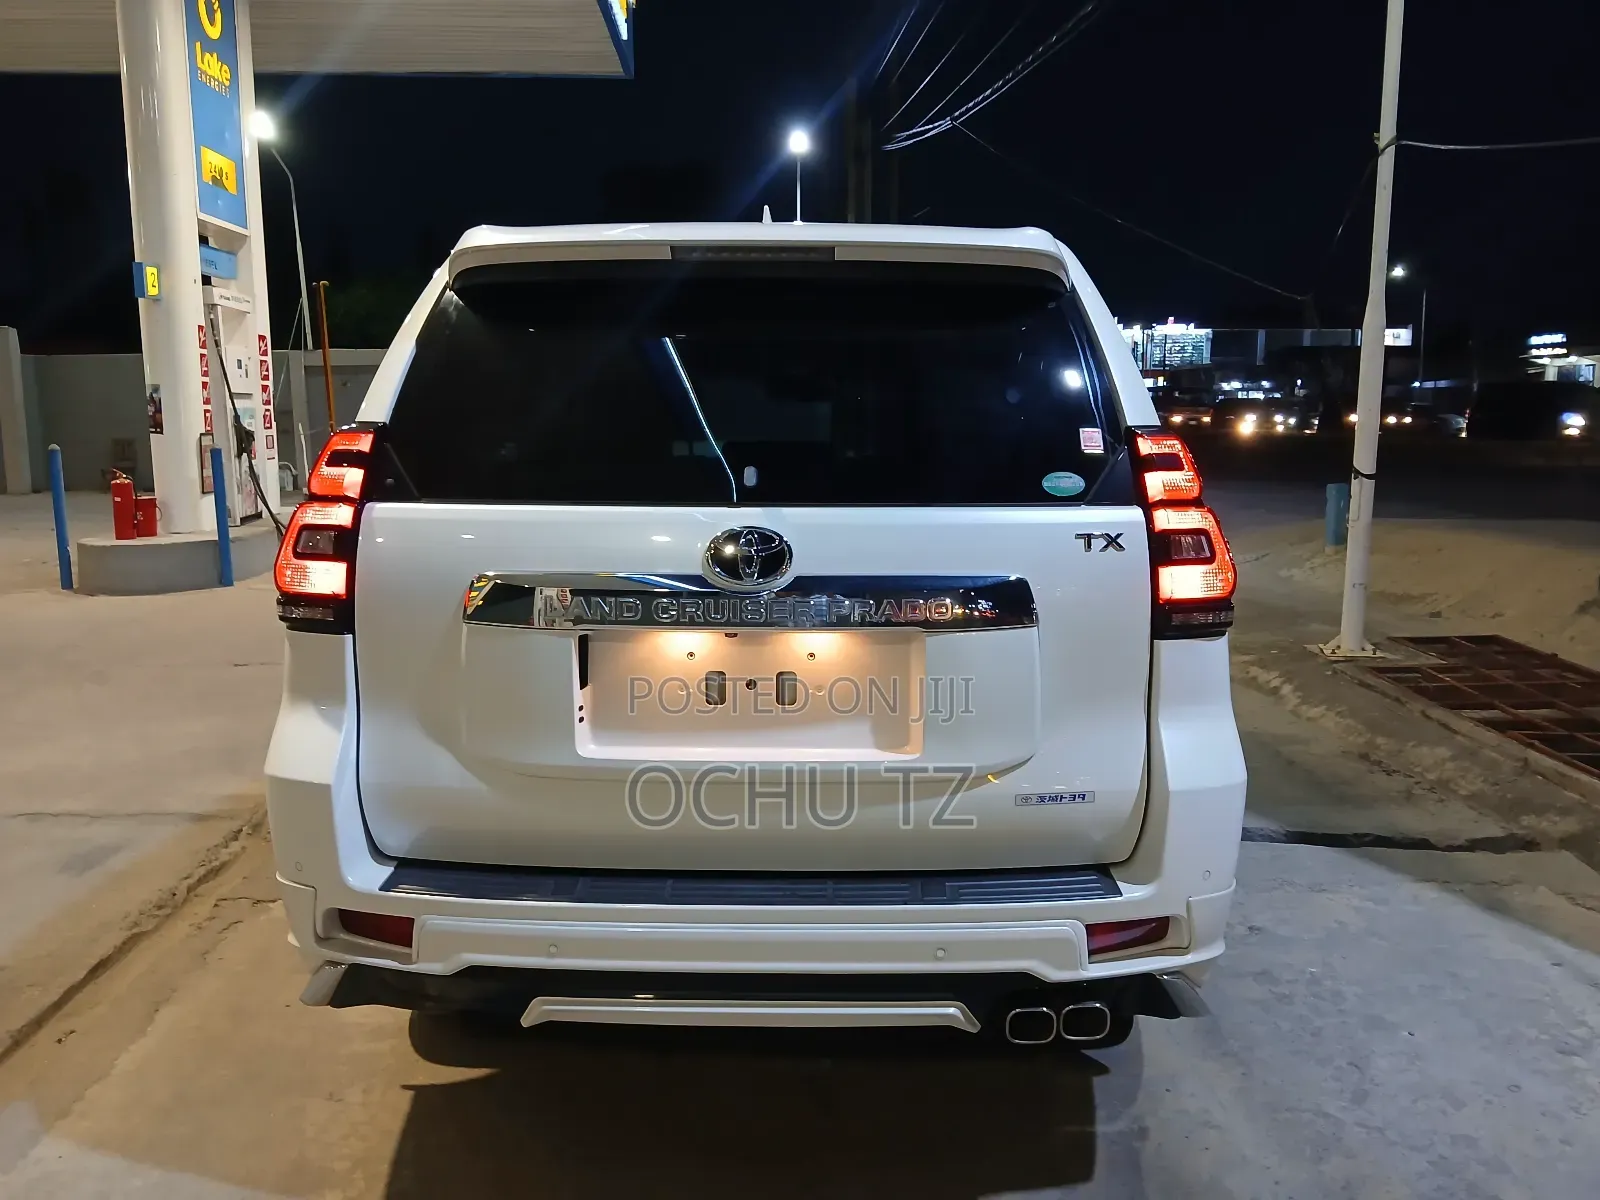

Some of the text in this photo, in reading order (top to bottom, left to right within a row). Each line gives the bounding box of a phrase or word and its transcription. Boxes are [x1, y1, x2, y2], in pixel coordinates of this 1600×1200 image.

[195, 41, 231, 87] Lake
[197, 69, 230, 99] ENERGIES
[151, 272, 157, 288] 2
[1074, 532, 1126, 552] TX
[543, 596, 643, 622] LAND
[652, 598, 817, 623] CRUISER
[826, 597, 955, 623] PRADO
[1036, 793, 1086, 804] 茨城トヨタ
